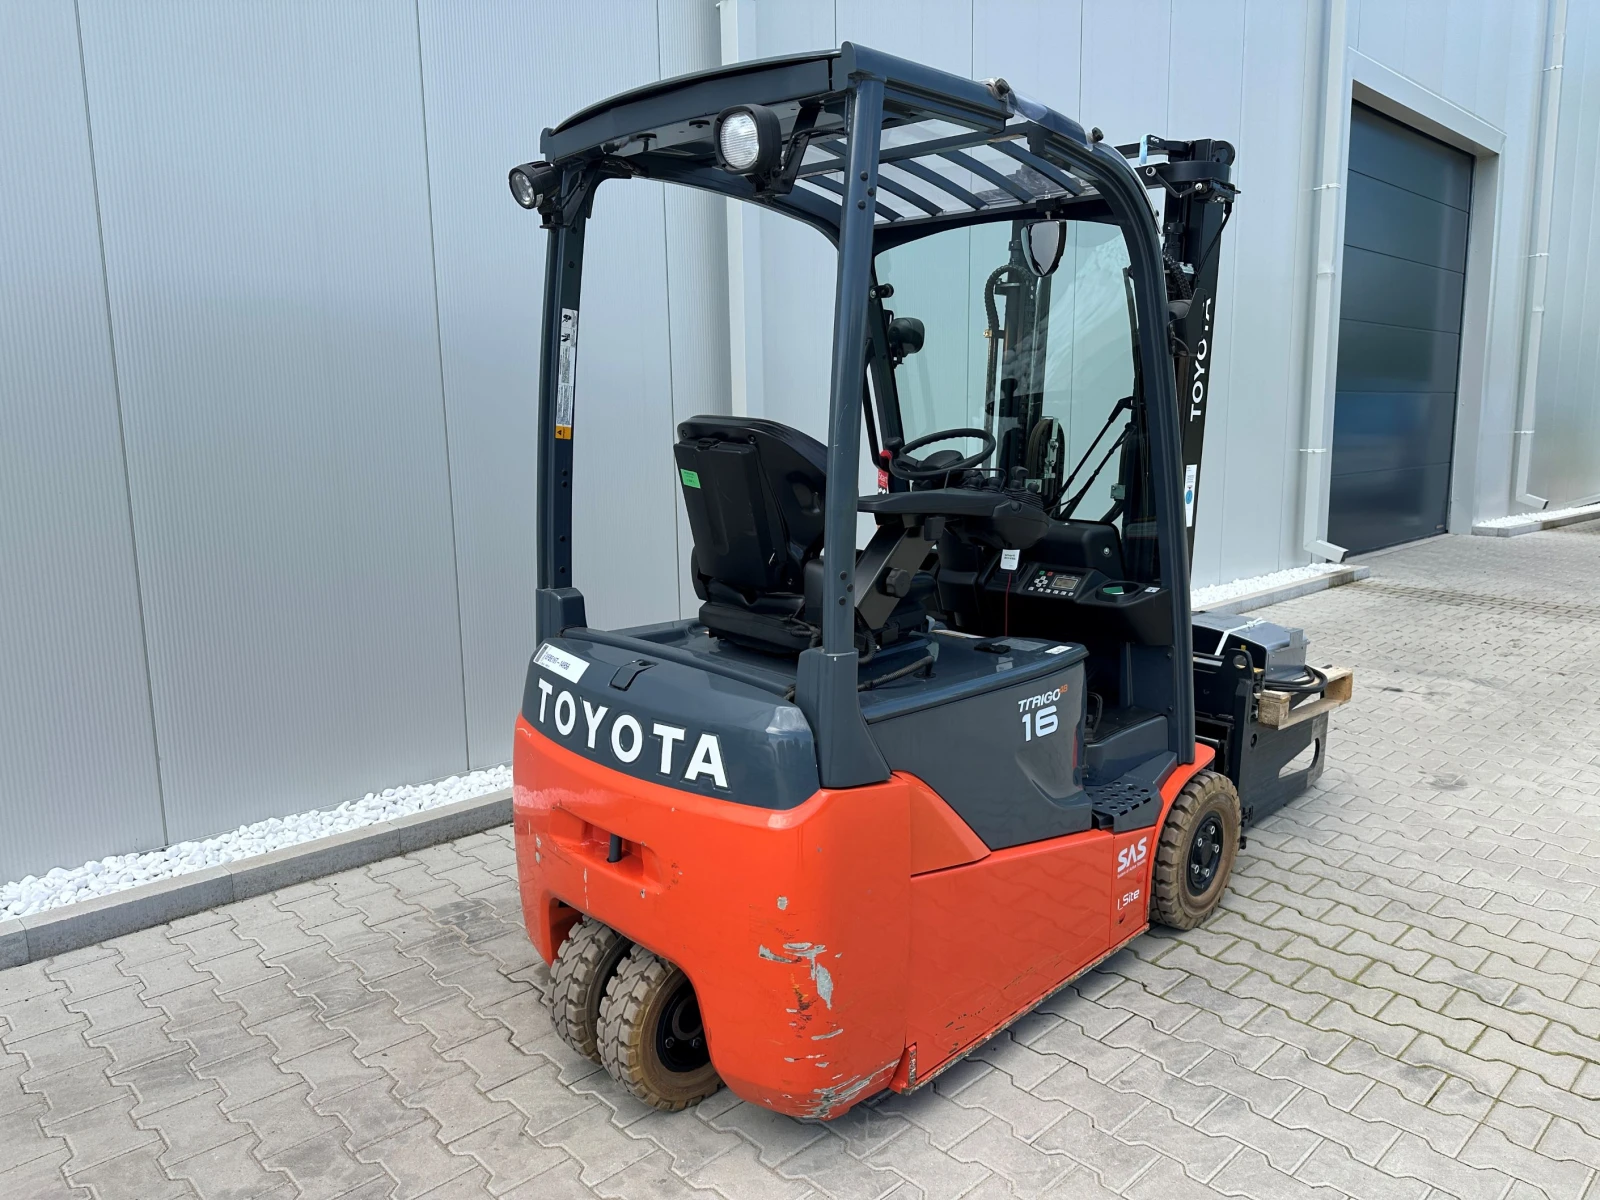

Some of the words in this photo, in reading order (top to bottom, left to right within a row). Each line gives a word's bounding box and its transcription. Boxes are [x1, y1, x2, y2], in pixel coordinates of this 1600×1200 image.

[1190, 298, 1211, 422] TOYOA
[538, 678, 728, 788] TOYOTA
[1021, 705, 1059, 742] 16
[1117, 836, 1147, 873] SAS
